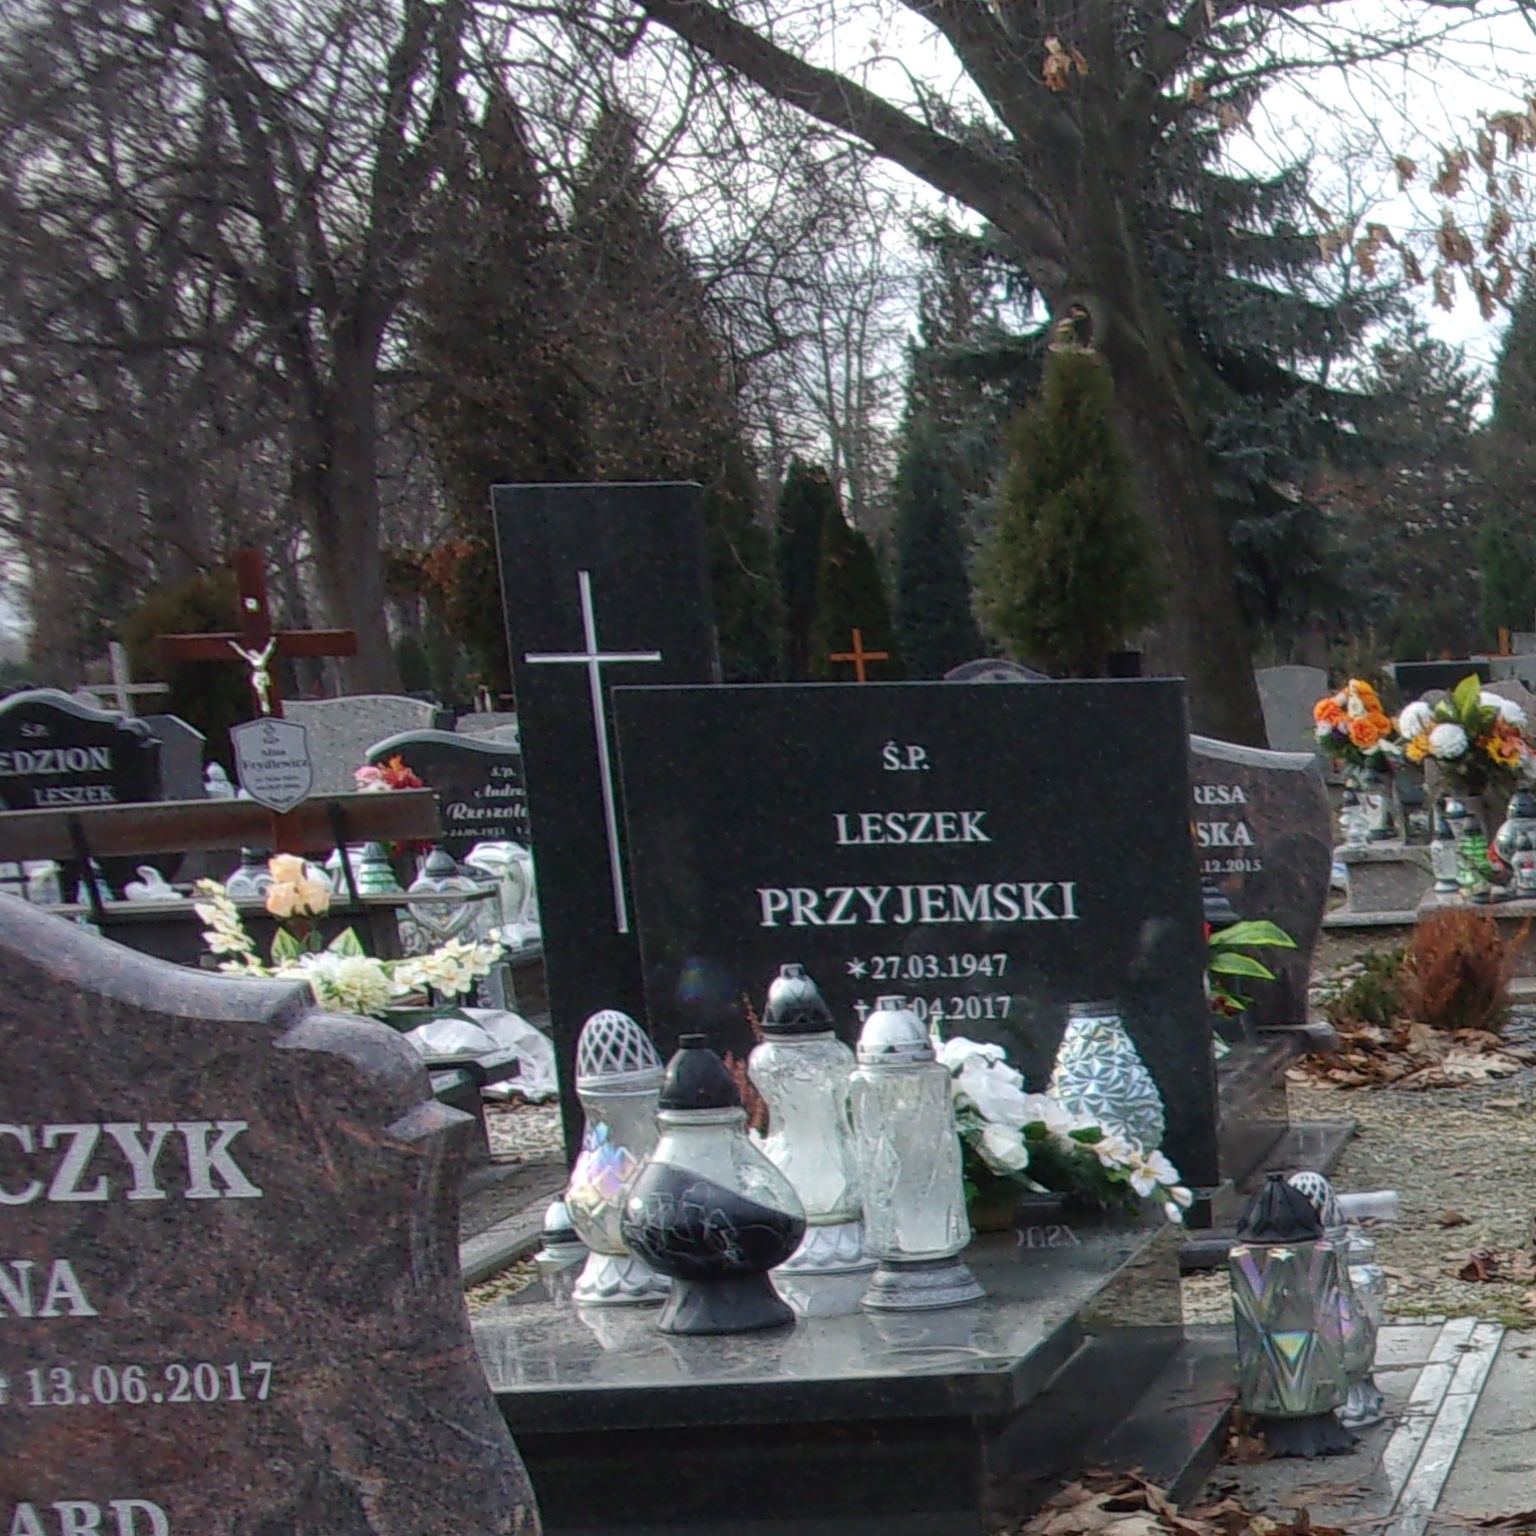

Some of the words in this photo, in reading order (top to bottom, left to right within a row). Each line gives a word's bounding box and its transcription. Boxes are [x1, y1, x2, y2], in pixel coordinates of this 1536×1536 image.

[881, 740, 931, 771] Ś.P.
[33, 785, 119, 806] LESZEK
[833, 811, 992, 845] LESZEK
[756, 881, 1081, 927] PRZYJEMSKI
[911, 995, 1012, 1020] 04.2017
[25, 1361, 273, 1406] 13.06.2017
